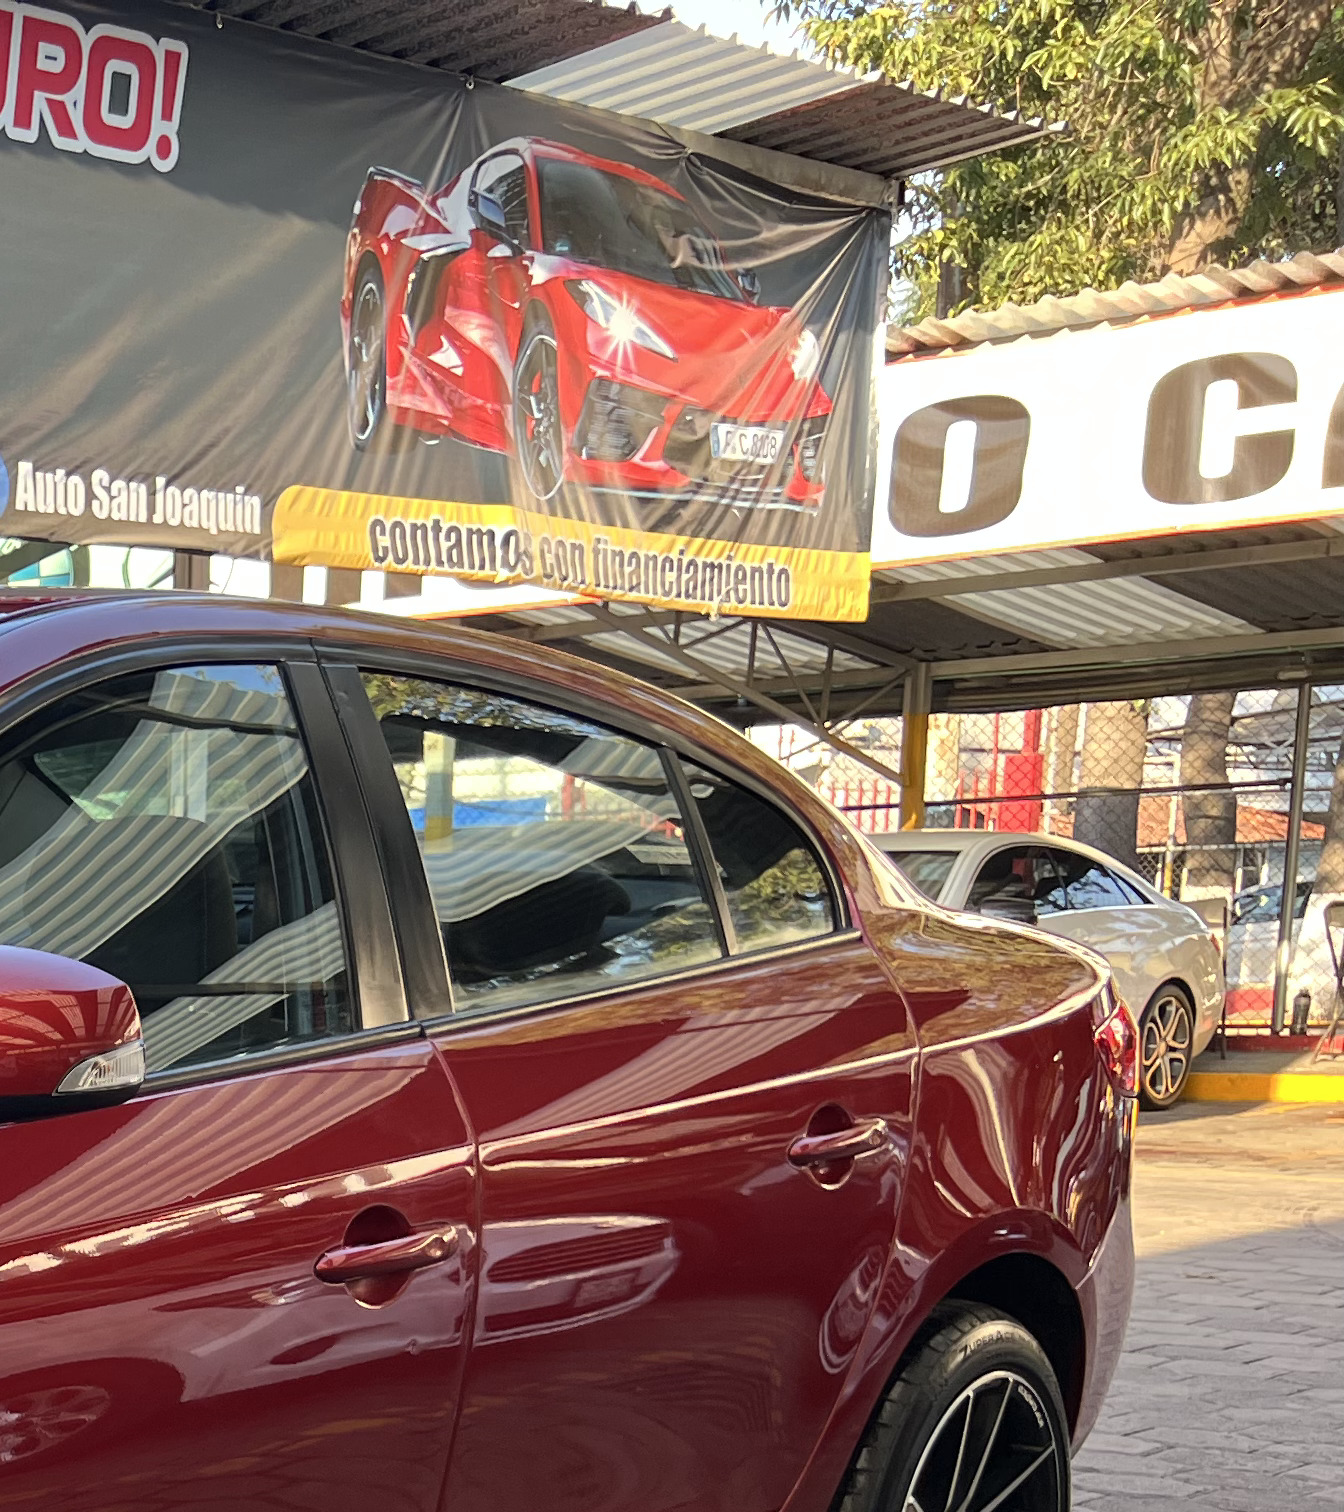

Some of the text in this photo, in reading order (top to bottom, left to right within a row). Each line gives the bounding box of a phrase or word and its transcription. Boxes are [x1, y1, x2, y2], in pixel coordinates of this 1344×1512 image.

[1141, 351, 1344, 504] C
[15, 460, 86, 518] Auto
[91, 467, 148, 524] San
[152, 475, 262, 536] Joaquin
[369, 517, 792, 609] contamos con financiamiento
